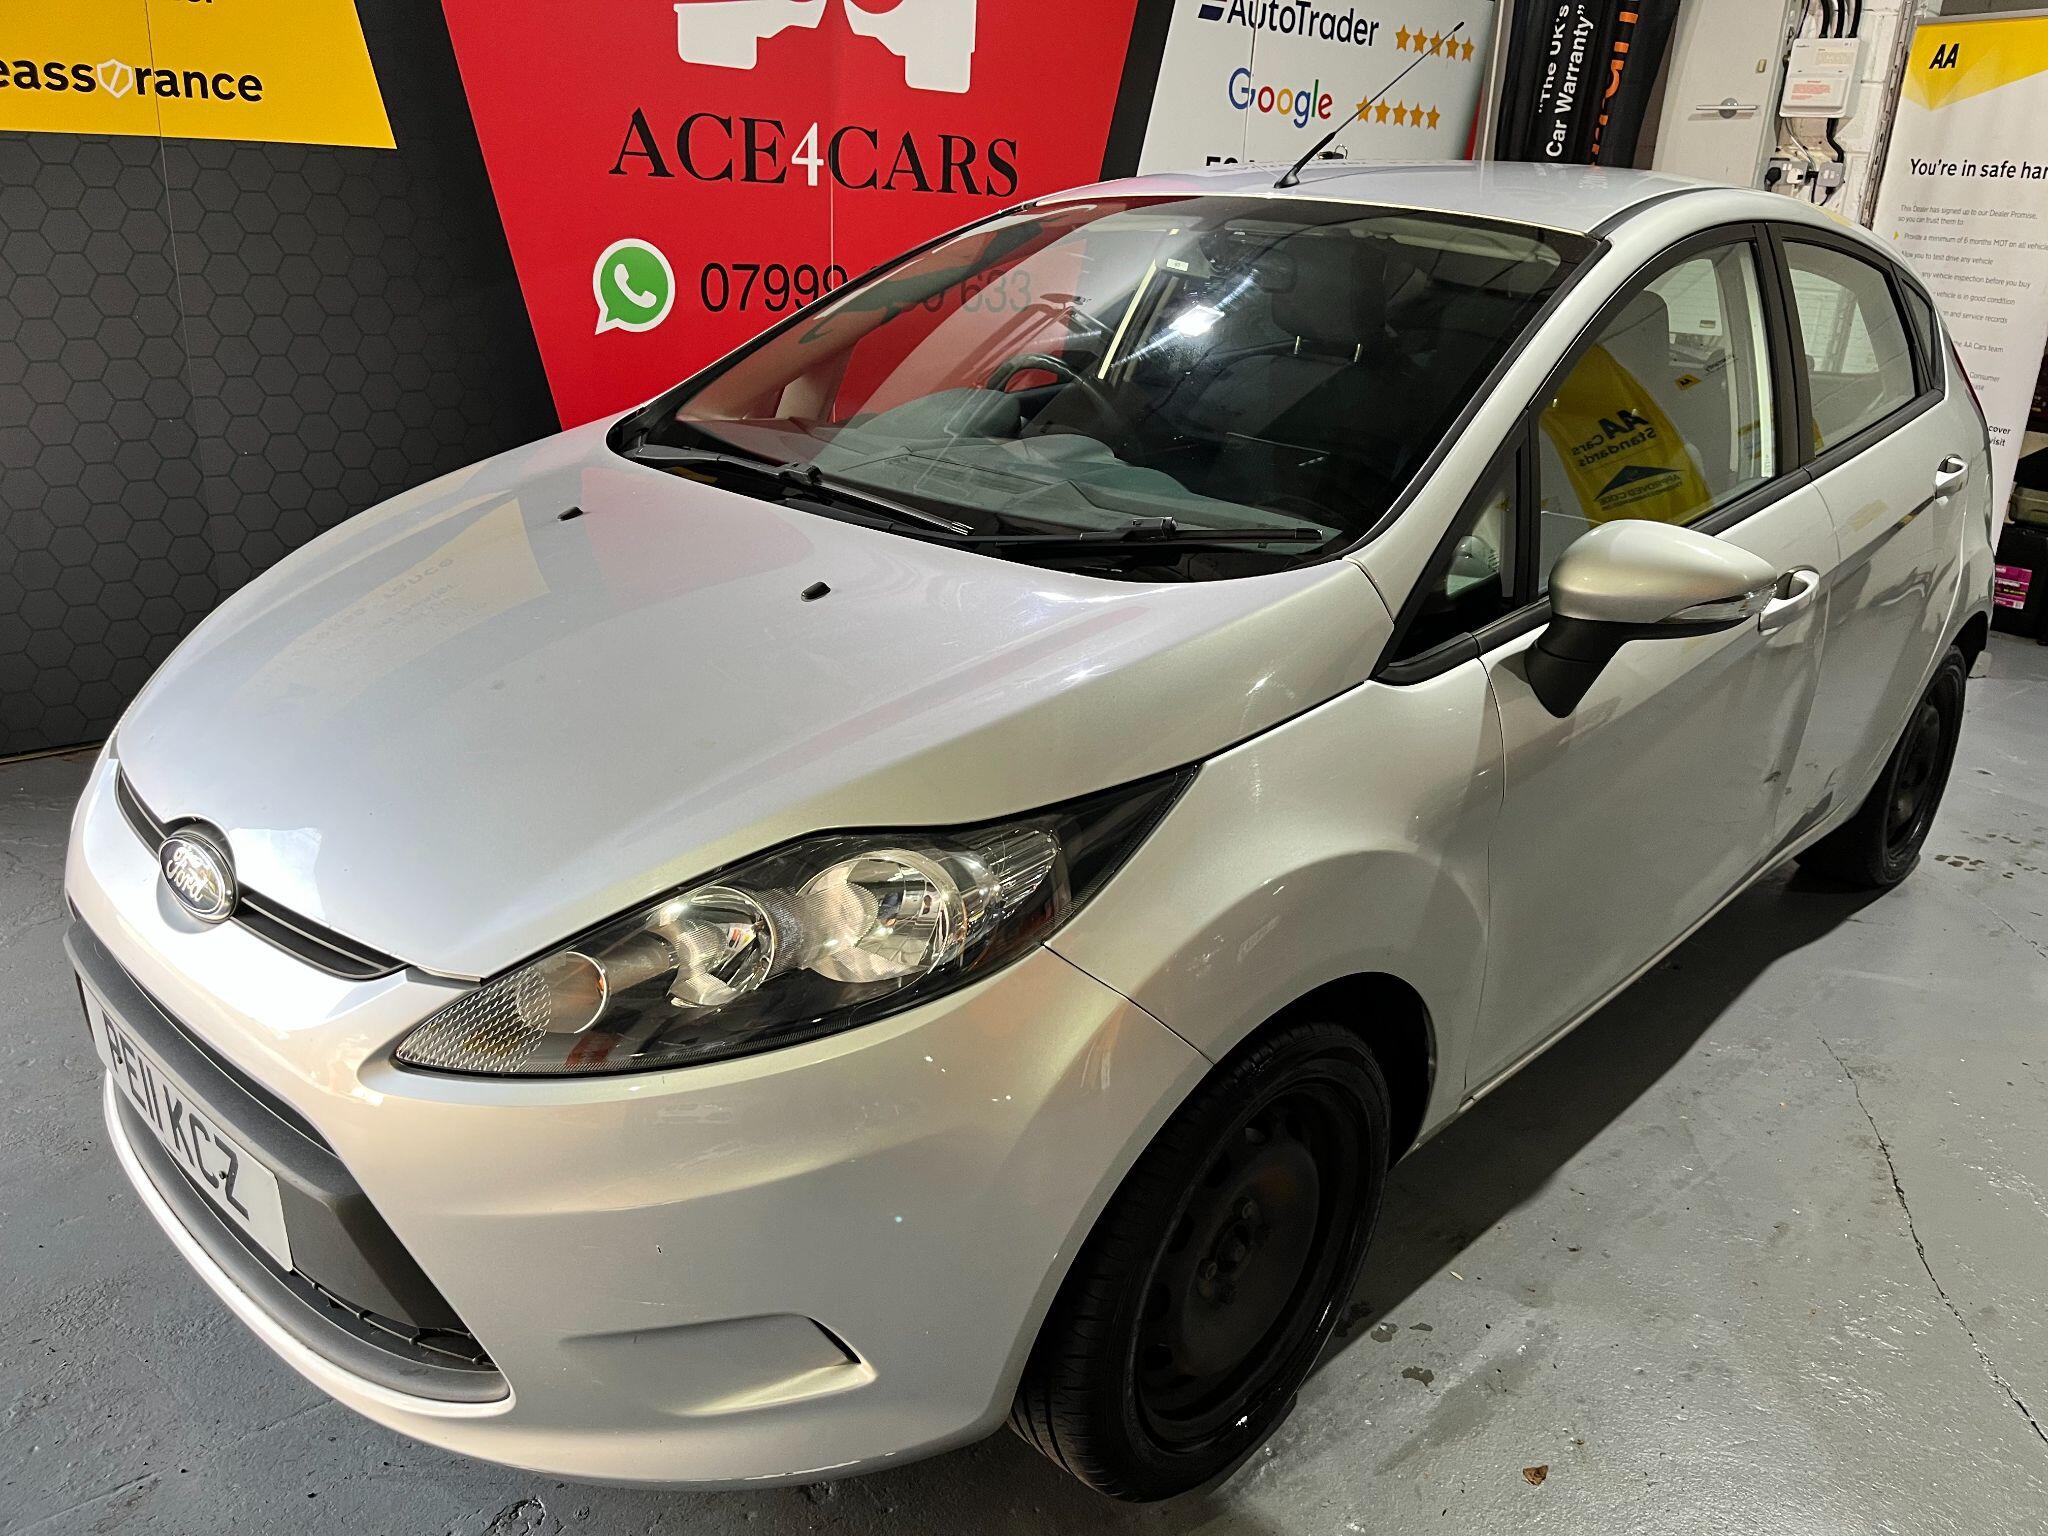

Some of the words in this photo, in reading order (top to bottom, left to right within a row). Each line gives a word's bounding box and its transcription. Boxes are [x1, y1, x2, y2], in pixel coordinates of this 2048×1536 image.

[1227, 0, 1380, 47] AutoTrader
[1928, 43, 1960, 69] AA
[1228, 67, 1333, 128] Google
[1546, 119, 1568, 157] Car
[608, 107, 1018, 198] ACE4CARS
[1910, 158, 1957, 176] You're
[1961, 160, 1976, 177] in
[1980, 160, 2016, 178] safe
[1901, 204, 1912, 212] This
[1990, 209, 2010, 217] Dealer
[1993, 238, 2008, 247] MOT
[1972, 256, 1994, 265] vehicle
[1933, 271, 1953, 280] vehicle
[1954, 273, 1984, 283] inspection
[1985, 276, 2004, 286] before
[2005, 279, 2017, 287] you
[2018, 280, 2031, 290] buy
[1936, 290, 1956, 299] vehicle
[1970, 294, 1986, 303] good
[1986, 296, 2016, 306] condition
[1949, 310, 1961, 318] and
[1962, 312, 1984, 320] service
[1985, 315, 2008, 324] records
[1973, 342, 1987, 351] Cars
[1988, 345, 2004, 353] team
[1969, 371, 2000, 383] Consumer
[166, 846, 209, 902] Ford
[163, 1084, 250, 1222] KCZ
